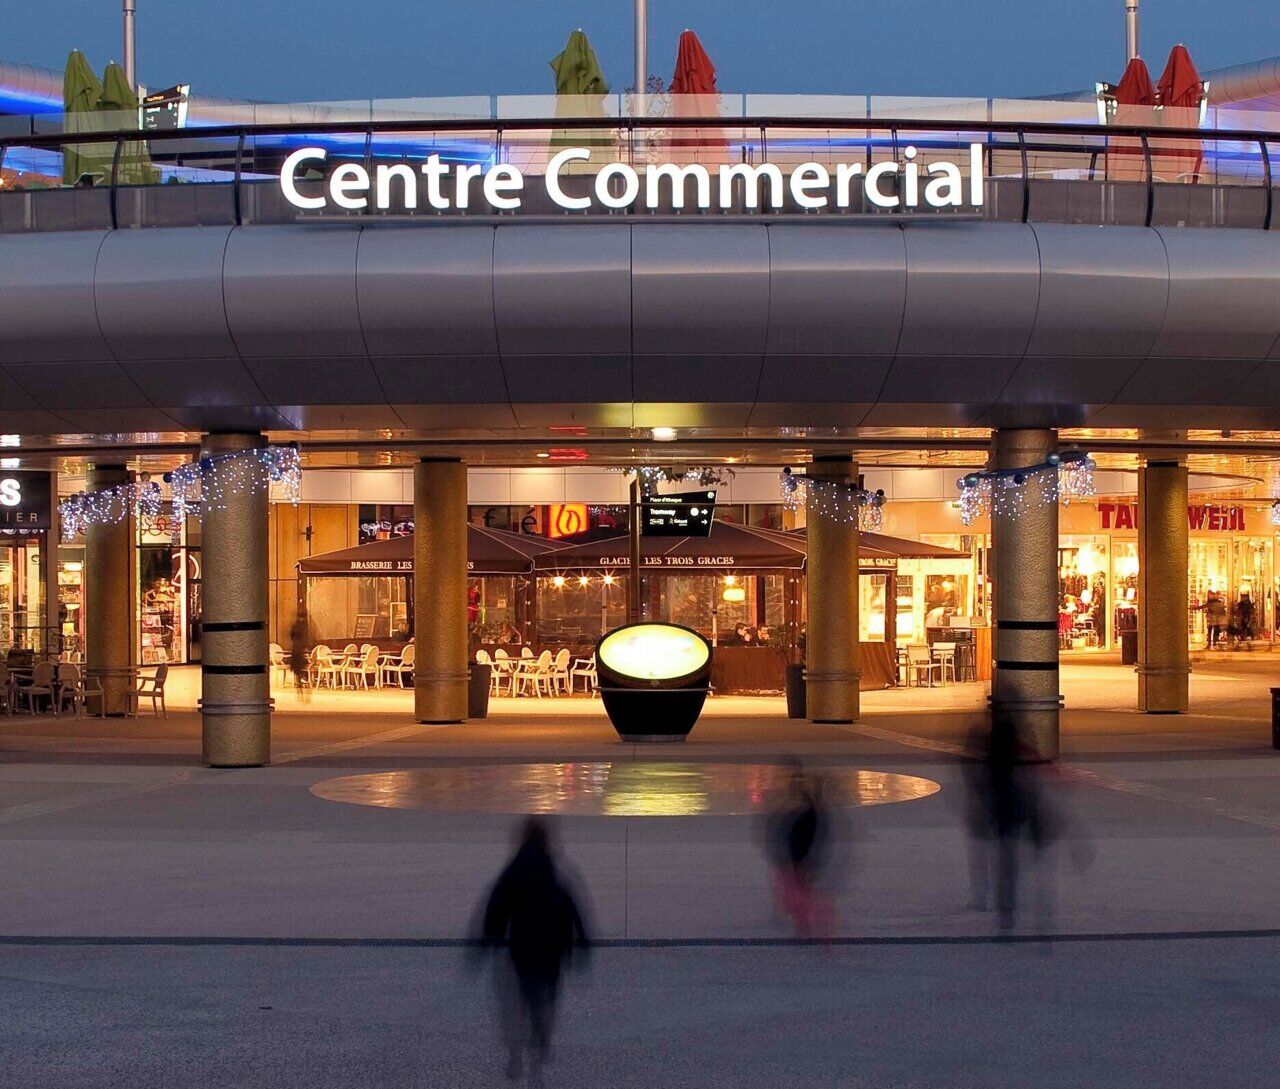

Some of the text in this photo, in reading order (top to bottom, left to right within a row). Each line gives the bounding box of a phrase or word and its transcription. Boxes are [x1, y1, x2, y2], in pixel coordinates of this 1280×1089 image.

[280, 143, 984, 209] Centre Commercial
[645, 557, 662, 565] LES
[665, 557, 694, 565] TROIS
[698, 556, 734, 565] GRACES
[350, 561, 393, 570] BRASSERIE
[397, 561, 412, 570] LES
